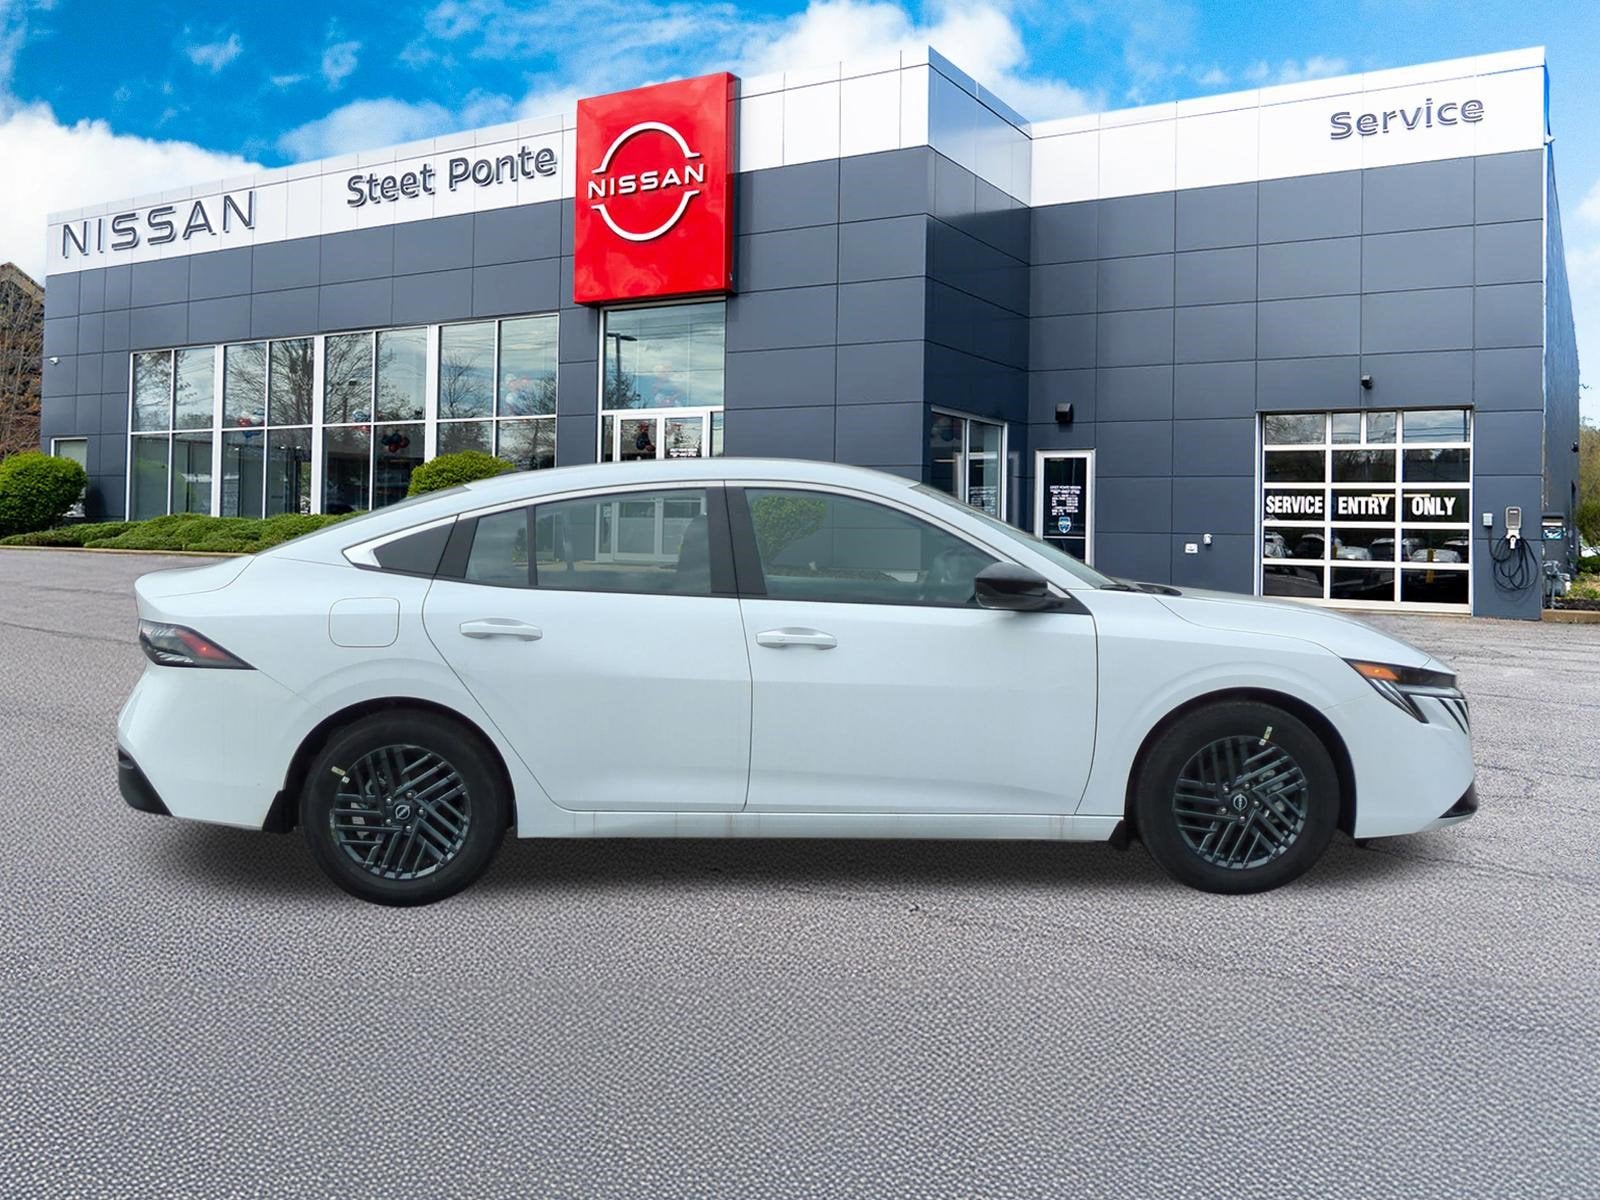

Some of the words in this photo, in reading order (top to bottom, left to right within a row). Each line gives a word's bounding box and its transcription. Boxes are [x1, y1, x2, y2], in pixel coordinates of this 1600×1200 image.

[1330, 97, 1484, 140] Service
[346, 163, 436, 208] Steet
[448, 145, 558, 192] Ponte
[587, 162, 705, 200] NISSAN
[62, 190, 256, 259] NISSAN
[1265, 495, 1323, 514] SERVICE
[1338, 496, 1390, 516] ENTRY
[1411, 496, 1456, 516] ONLY
